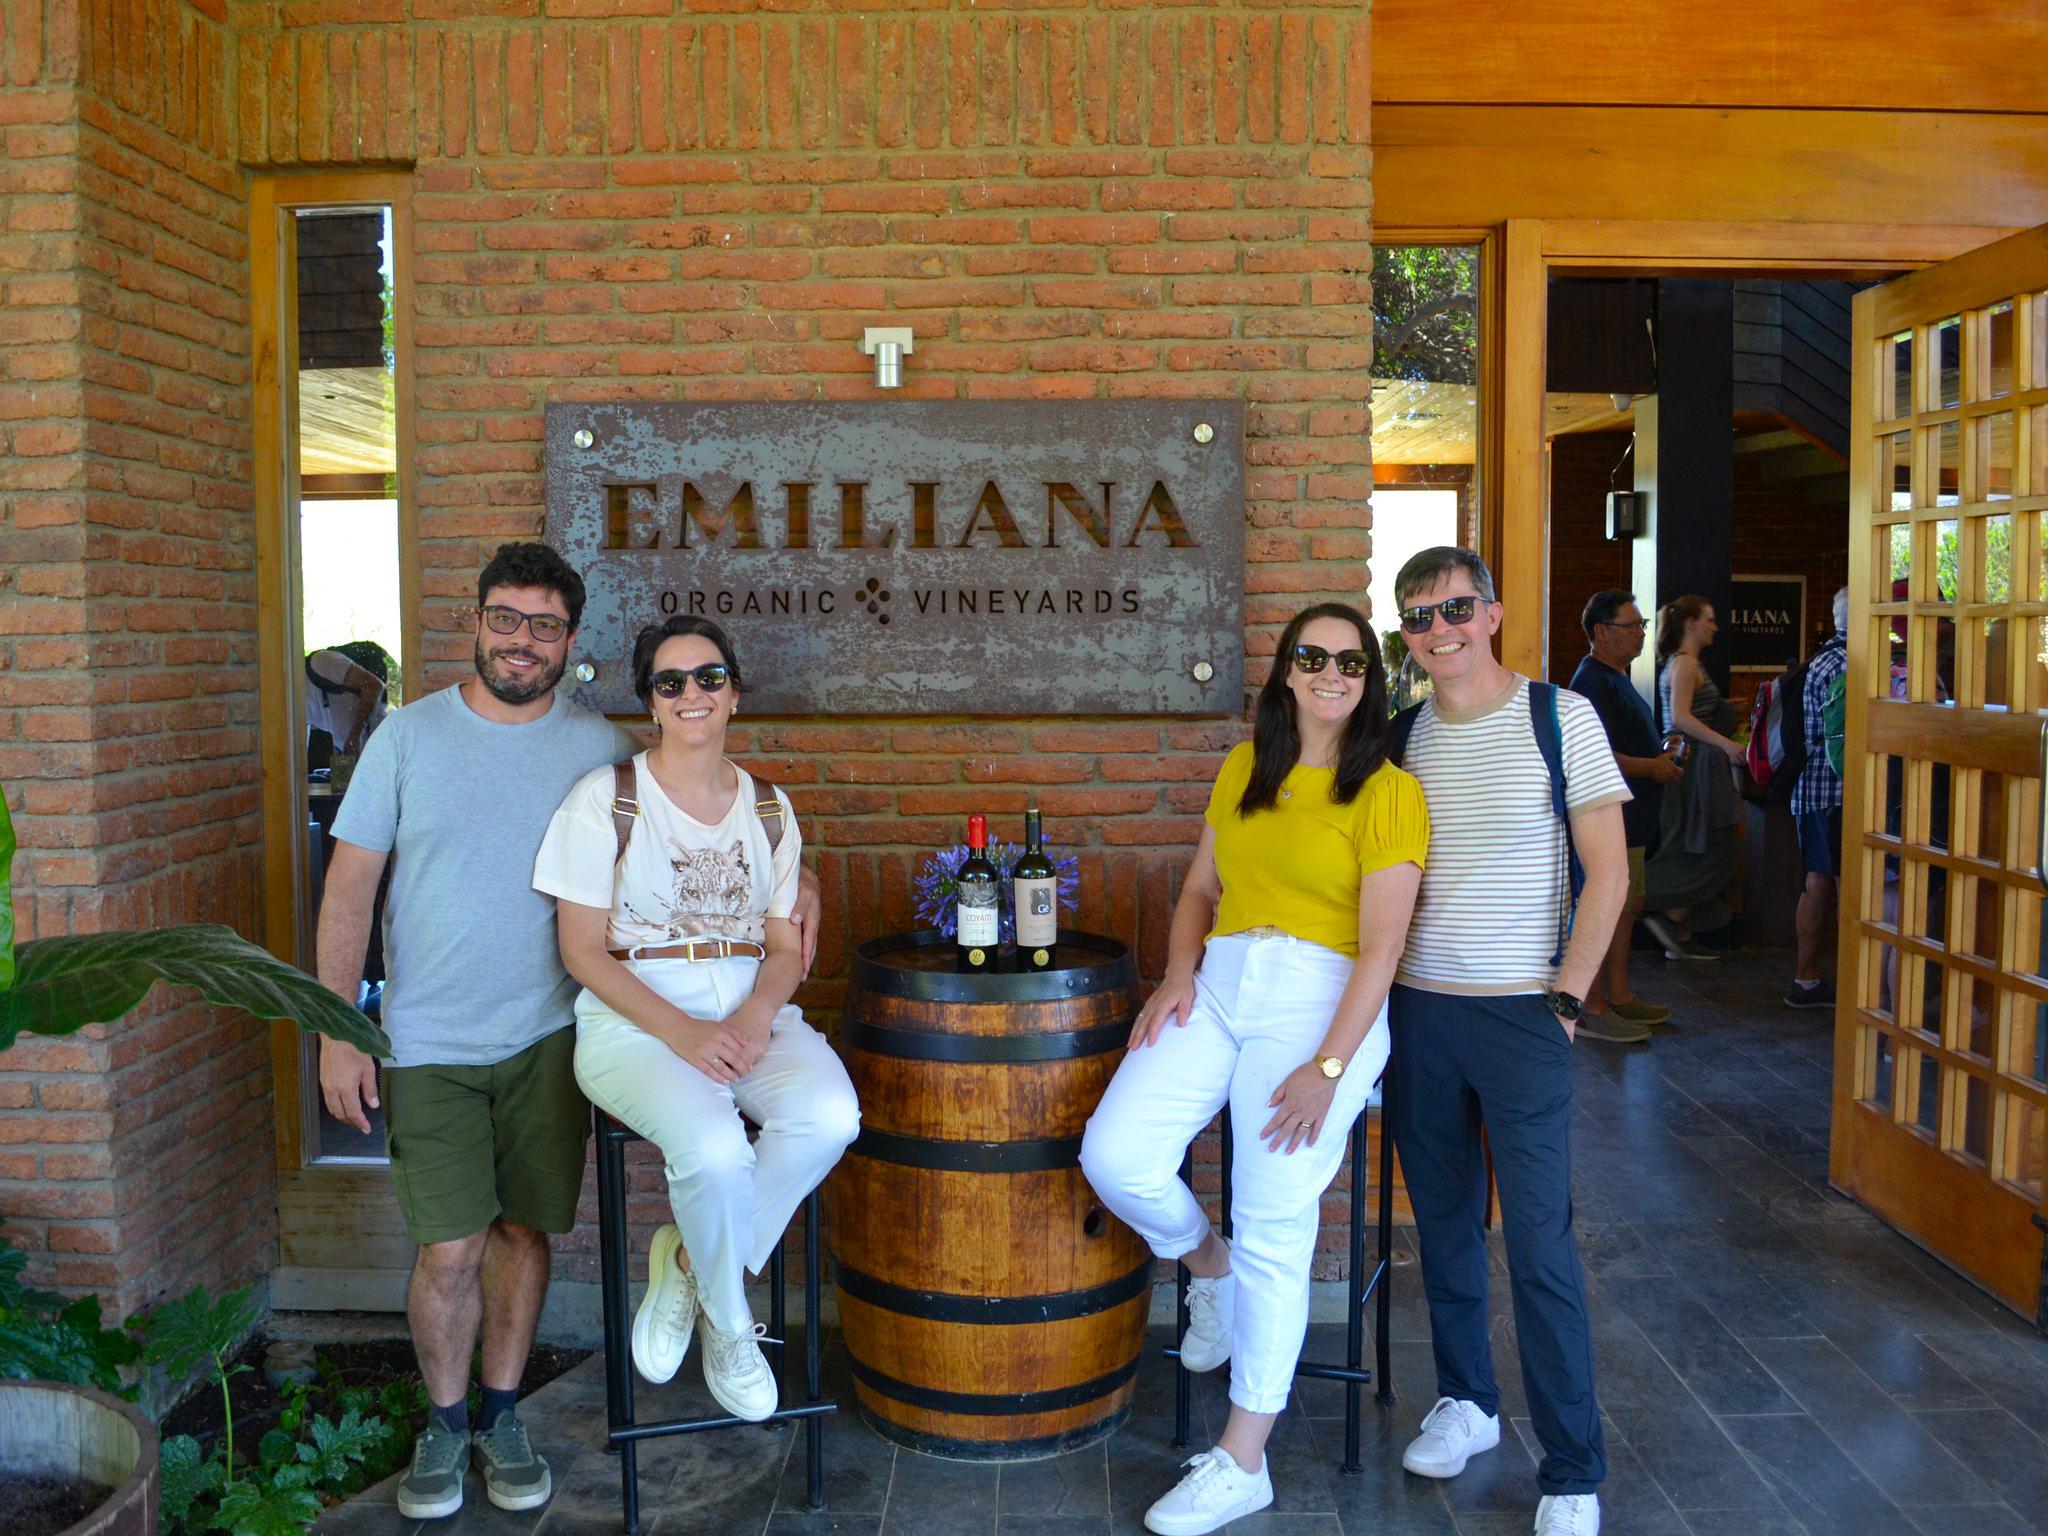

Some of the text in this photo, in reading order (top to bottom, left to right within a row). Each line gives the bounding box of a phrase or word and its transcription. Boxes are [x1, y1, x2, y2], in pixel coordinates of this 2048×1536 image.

[601, 480, 1200, 549] EMILIANA
[660, 590, 1139, 614] ORGANIC VINEYARDS
